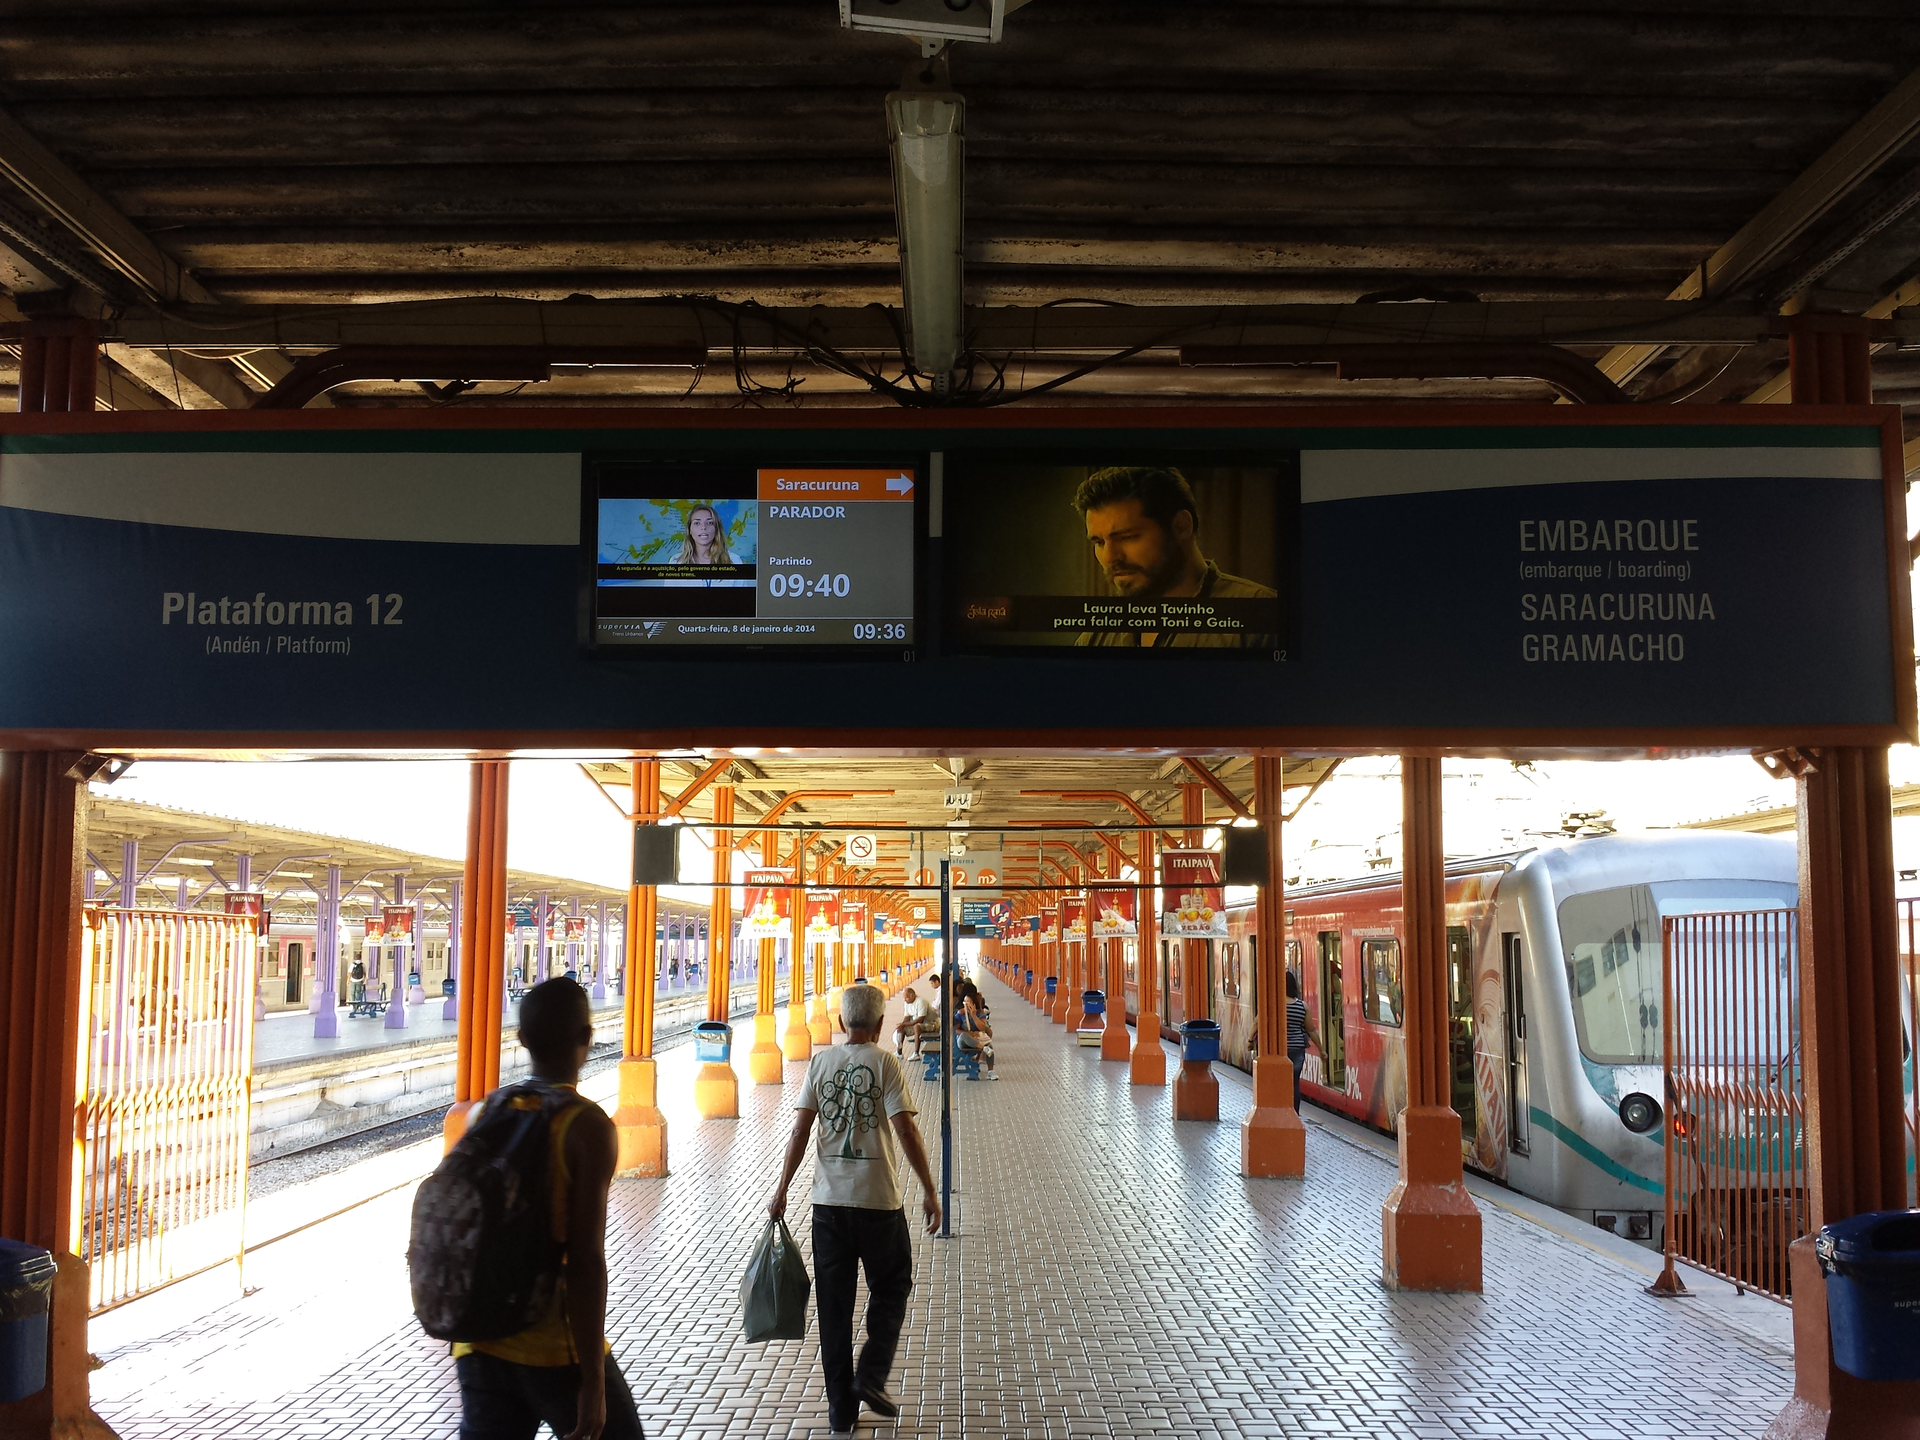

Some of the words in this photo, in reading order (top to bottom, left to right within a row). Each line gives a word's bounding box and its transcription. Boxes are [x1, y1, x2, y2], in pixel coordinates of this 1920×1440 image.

[776, 478, 859, 491] Saracuruna
[769, 506, 846, 518] PARADOR
[1519, 519, 1700, 552] EMBARQUE
[769, 556, 812, 566] Partindo
[1519, 560, 1602, 582] (embarque
[1607, 560, 1612, 579] /
[1618, 560, 1691, 582] boarding)
[769, 573, 850, 598] 09:40
[162, 592, 353, 626] Plataforma
[366, 593, 404, 625] 12
[1084, 602, 1123, 614] Laura
[1128, 602, 1157, 614] leva
[1161, 603, 1215, 614] Tavinho
[1521, 592, 1716, 621] SARACURUNA
[1053, 617, 1086, 629] para
[1090, 614, 1123, 627] falar
[1128, 618, 1156, 627] com
[1161, 615, 1189, 628] Toni
[1193, 618, 1202, 628] e
[1206, 616, 1245, 628] Gaia.
[677, 624, 731, 635] Quarta-feira,
[732, 624, 738, 633] 8
[739, 624, 750, 633] de
[751, 624, 781, 635] janeiro
[782, 624, 793, 633] de
[795, 624, 816, 633] 2014
[853, 623, 906, 639] 09:36
[205, 635, 260, 656] (Andén
[265, 635, 272, 655] /
[277, 635, 351, 656] Platform)
[1522, 633, 1685, 662] GRAMACHO
[903, 650, 915, 663] 01
[1273, 649, 1287, 662] 02
[1173, 858, 1214, 869] ITAIPAVA
[751, 874, 785, 884] ITAIPAVA
